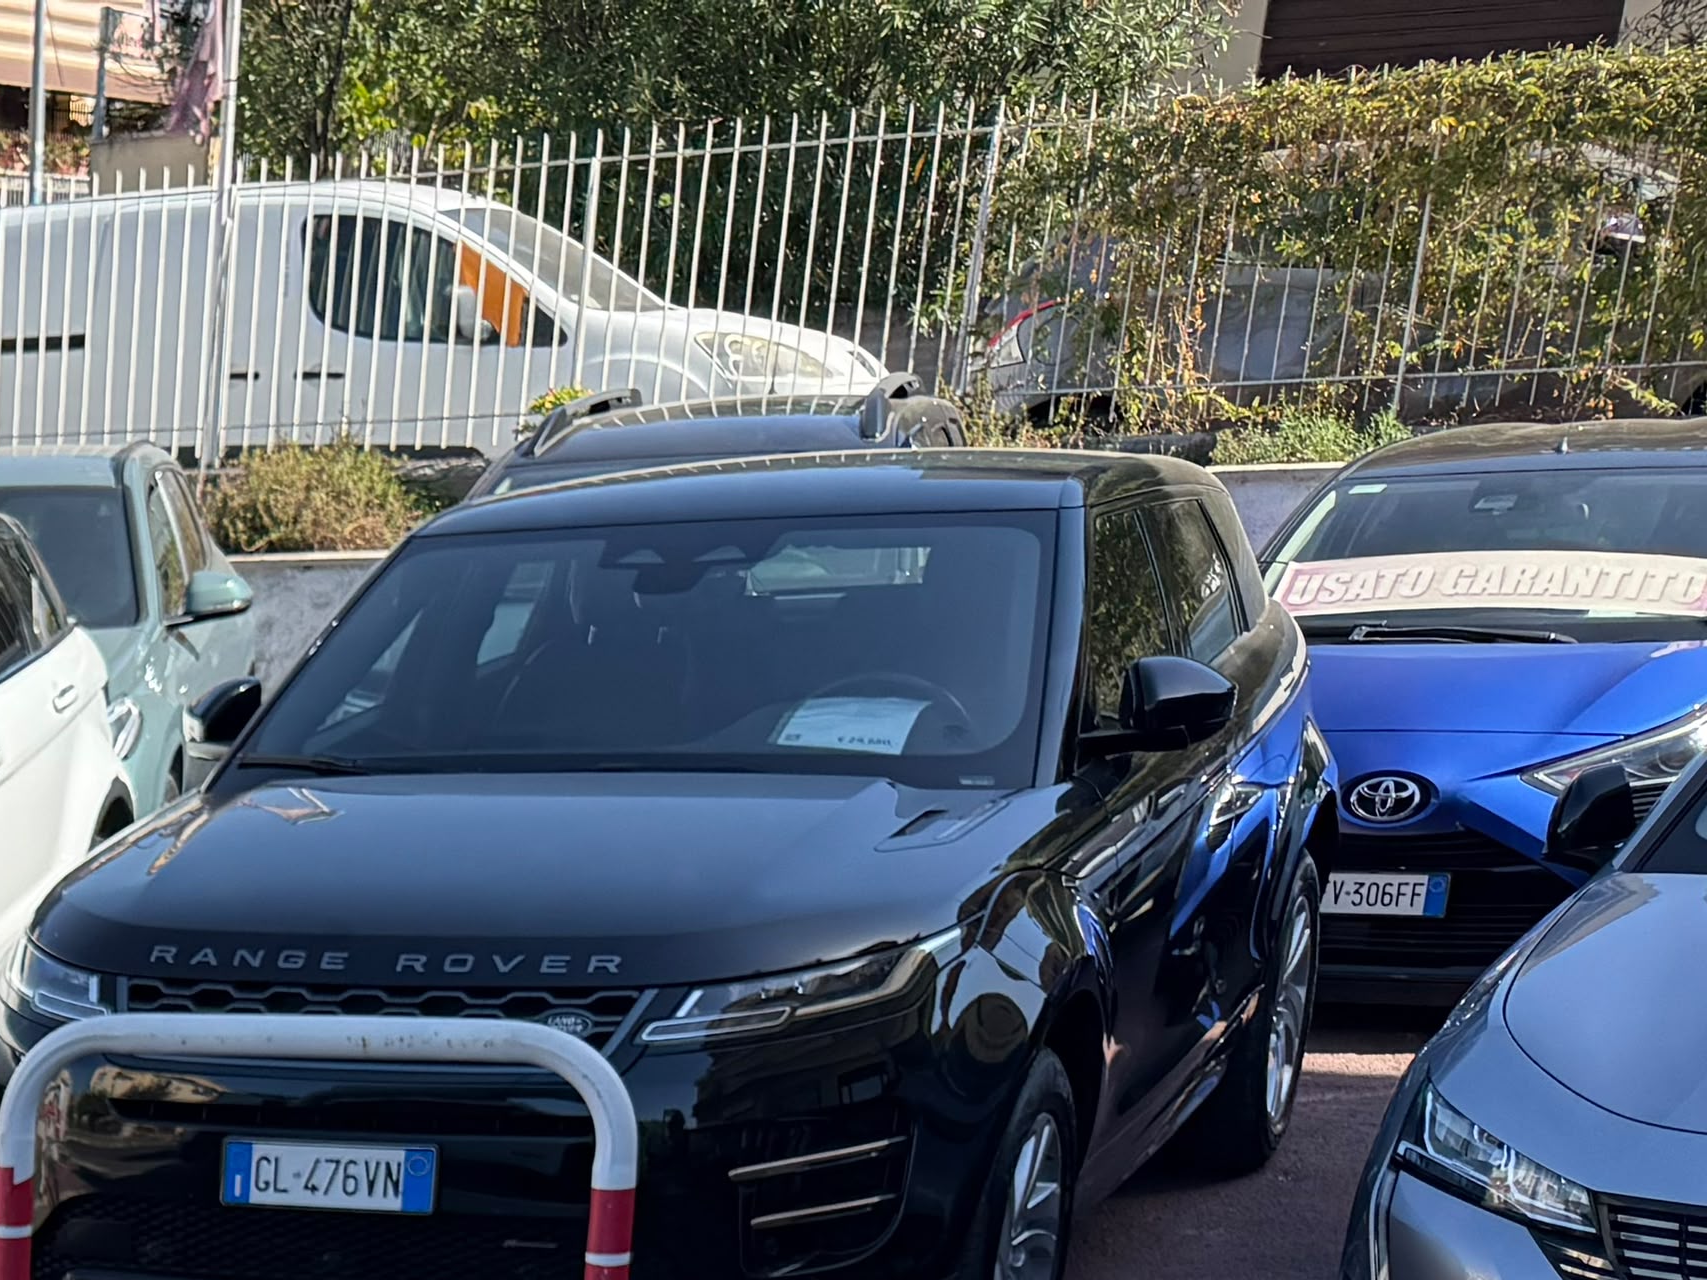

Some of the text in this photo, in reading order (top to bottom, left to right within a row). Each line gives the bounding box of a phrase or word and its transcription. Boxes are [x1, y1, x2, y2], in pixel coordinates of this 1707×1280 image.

[1288, 564, 1706, 606] USATO GARANTITO
[1350, 881, 1426, 907] 306FF
[149, 944, 623, 974] RANGE ROVER
[254, 1156, 288, 1193] GL
[303, 1158, 402, 1199] 476VN
